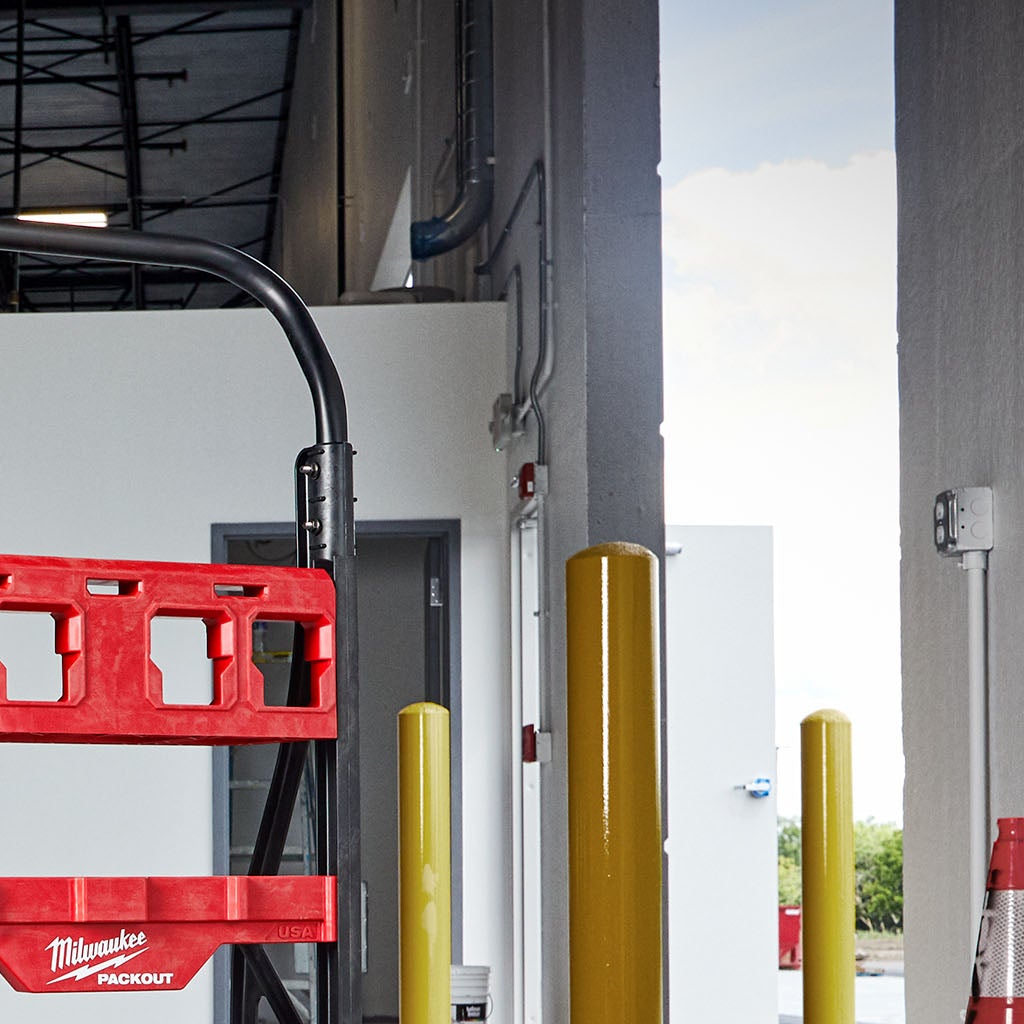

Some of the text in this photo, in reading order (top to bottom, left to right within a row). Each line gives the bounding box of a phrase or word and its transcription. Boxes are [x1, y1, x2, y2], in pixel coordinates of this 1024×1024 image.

[278, 925, 314, 939] USA
[45, 929, 147, 972] Milwaukee
[97, 973, 173, 985] PACKOUT
